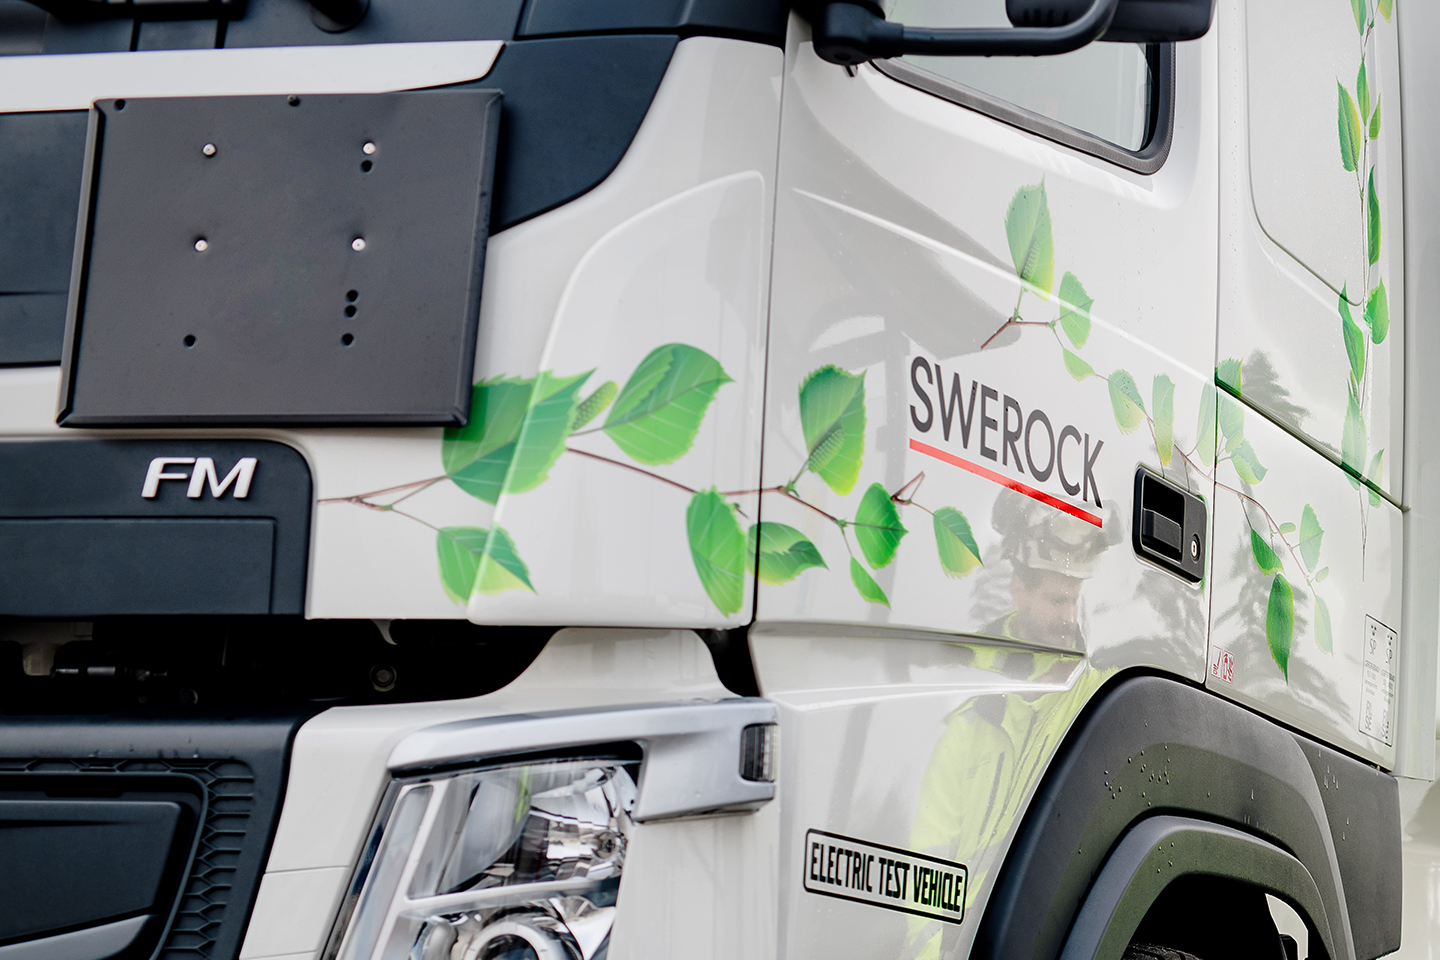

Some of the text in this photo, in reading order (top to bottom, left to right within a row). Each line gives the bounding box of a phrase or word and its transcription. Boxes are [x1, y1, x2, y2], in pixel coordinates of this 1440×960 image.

[909, 356, 1105, 509] SWEROCK
[141, 456, 258, 498] FM
[810, 841, 964, 913] ELECTRIC TEST VEHICLE
